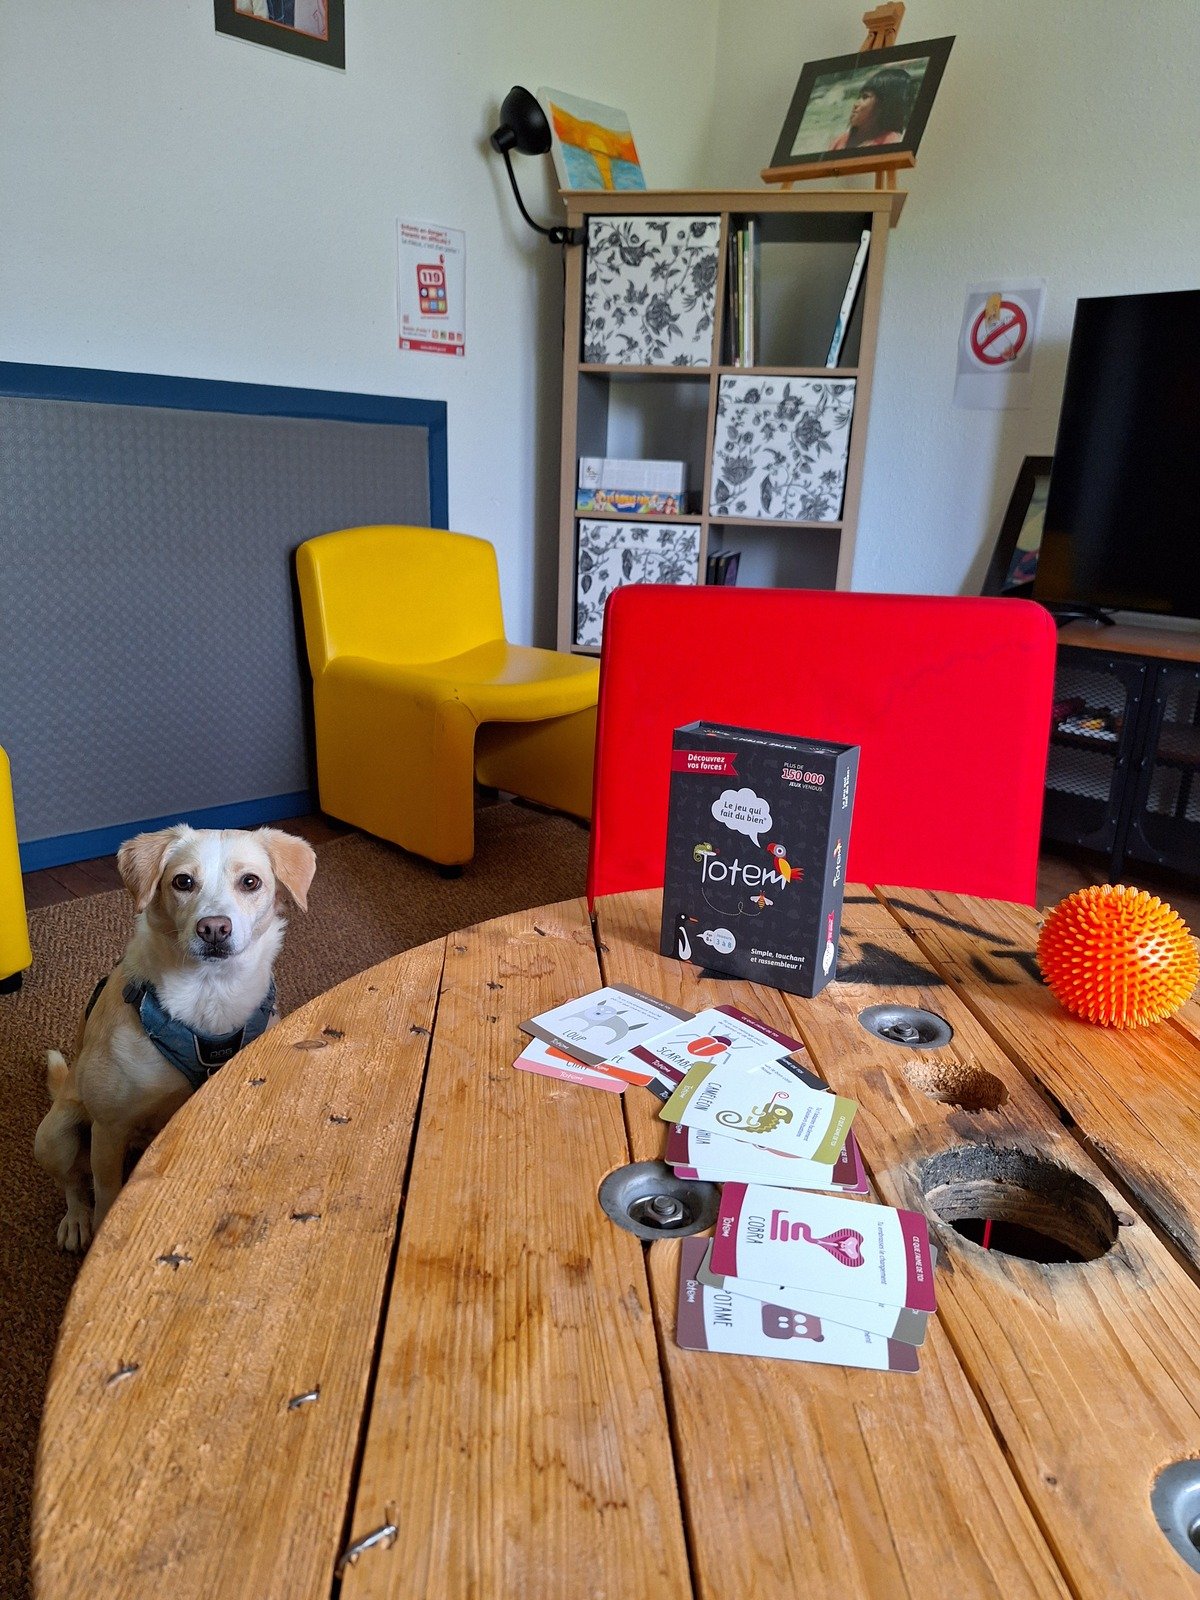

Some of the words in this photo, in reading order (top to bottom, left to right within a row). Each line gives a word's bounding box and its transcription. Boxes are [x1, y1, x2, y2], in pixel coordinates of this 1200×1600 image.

[422, 272, 440, 283] 119
[688, 754, 725, 763] Découvrez
[700, 762, 722, 770] forces
[781, 768, 802, 781] 150
[803, 772, 825, 785] 000
[802, 784, 823, 792] VENDUS
[720, 809, 733, 818] fait
[734, 803, 747, 812] jeu
[697, 851, 787, 890] Totem
[832, 845, 843, 887] Totem
[751, 948, 774, 958] Simple,
[775, 952, 805, 962] touchant
[758, 958, 798, 970] rassembleur
[562, 1030, 587, 1041] LOUP
[652, 1059, 671, 1073] Totem
[560, 1071, 583, 1081] Totem
[694, 1082, 722, 1112] CAMELEON
[722, 1216, 734, 1237] Totem
[746, 1216, 765, 1244] COBRA
[879, 1256, 887, 1285] changement
[916, 1266, 923, 1274] DE
